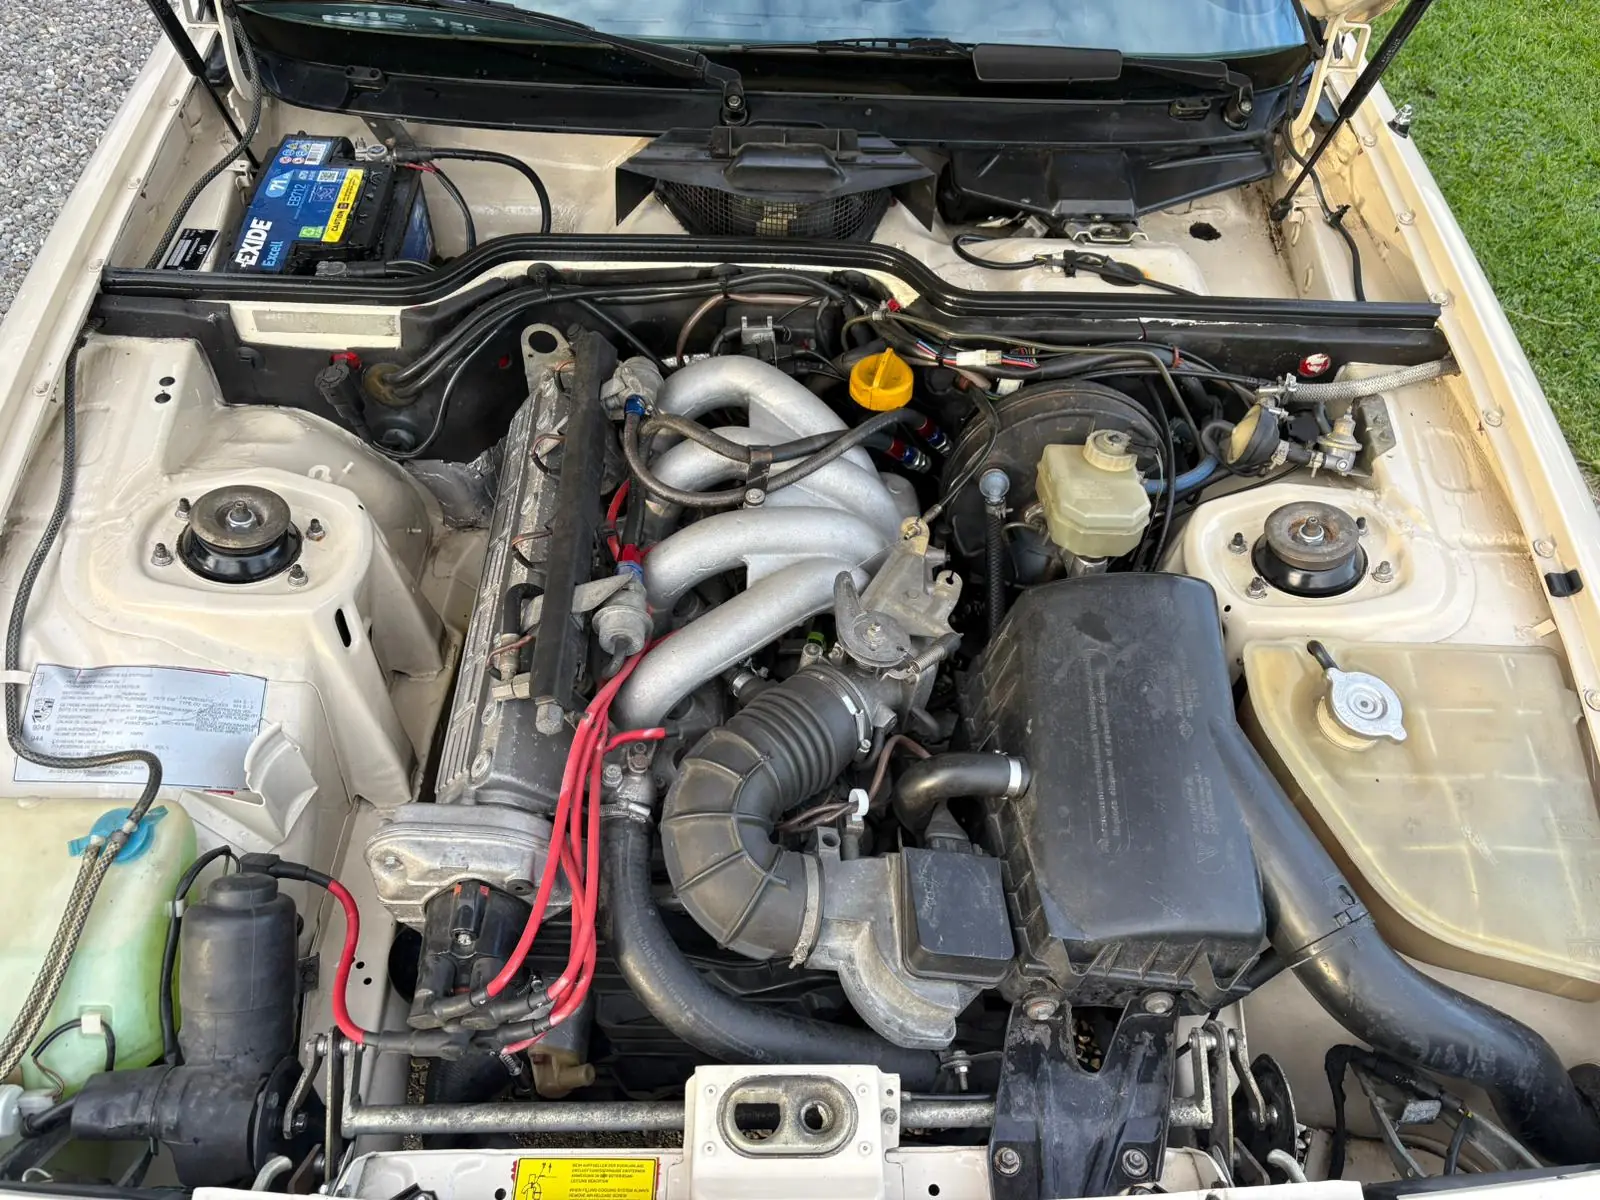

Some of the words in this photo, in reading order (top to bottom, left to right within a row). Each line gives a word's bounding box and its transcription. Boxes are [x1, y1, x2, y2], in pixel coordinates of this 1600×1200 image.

[270, 178, 289, 193] 71
[286, 183, 307, 206] EB712
[331, 211, 344, 232] CAUTION
[235, 217, 273, 267] EXIDE
[261, 241, 284, 267] Excell
